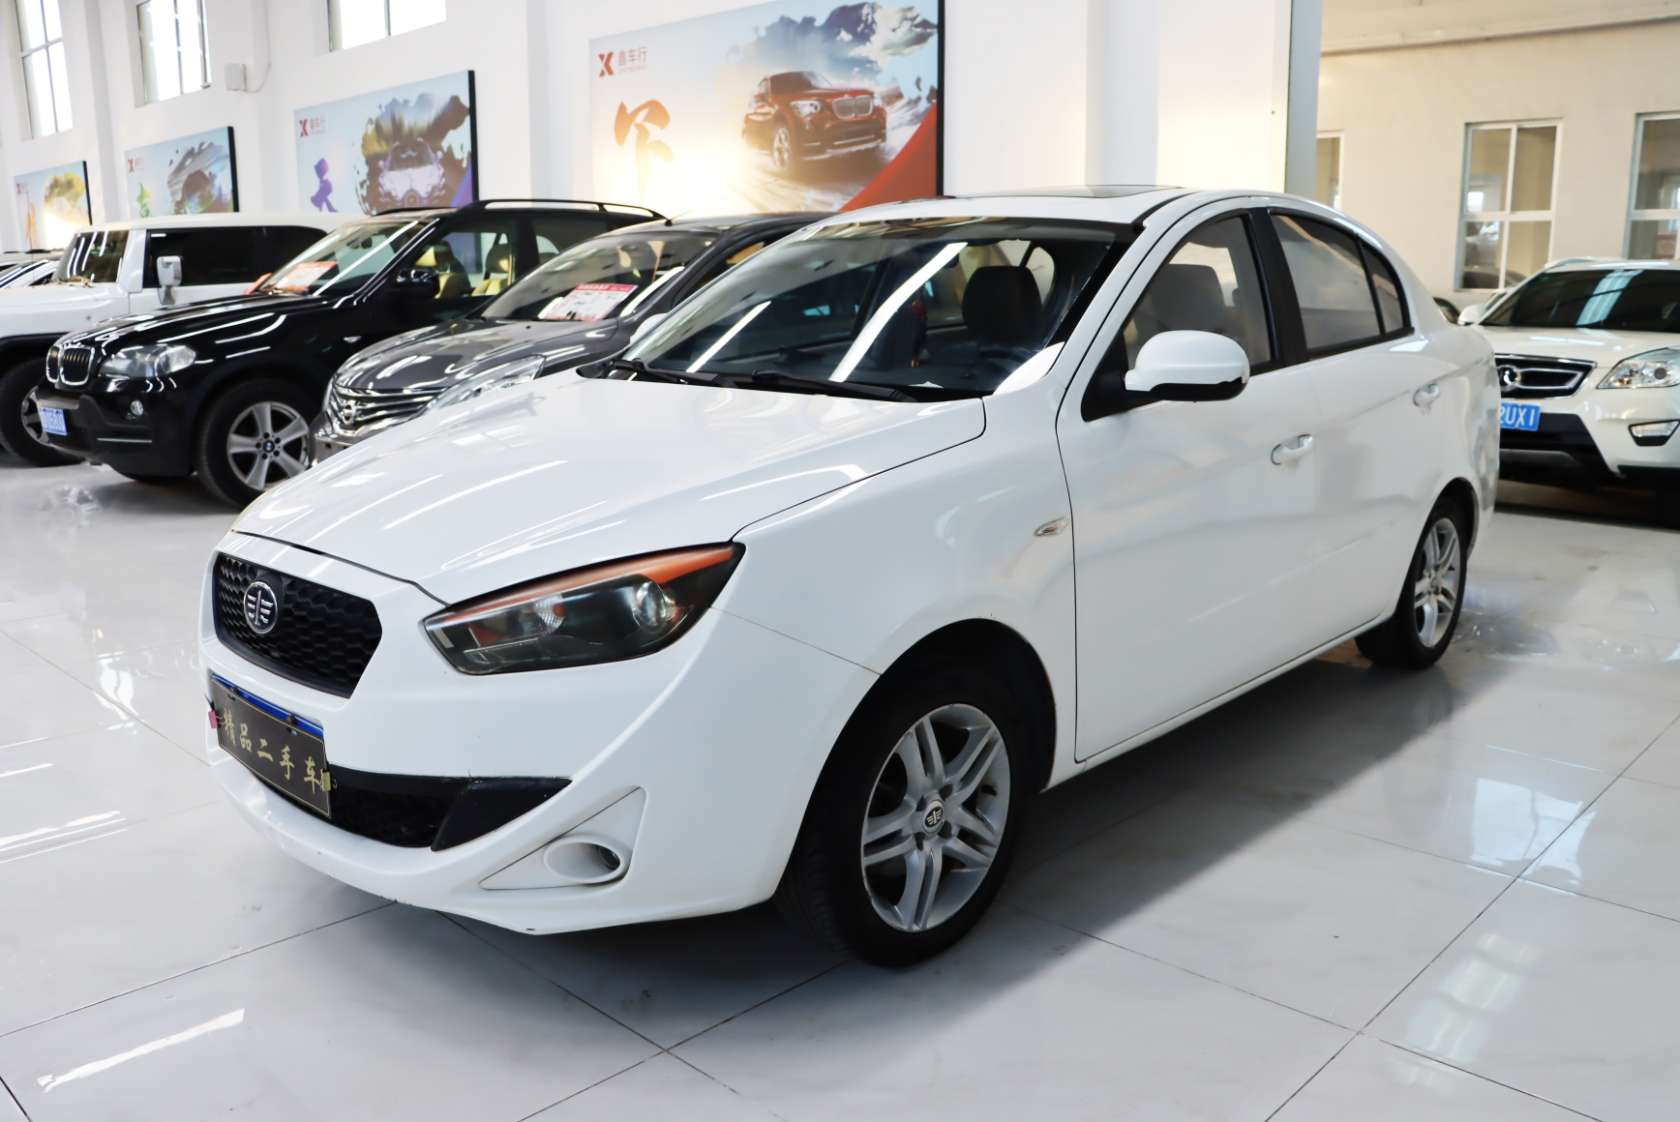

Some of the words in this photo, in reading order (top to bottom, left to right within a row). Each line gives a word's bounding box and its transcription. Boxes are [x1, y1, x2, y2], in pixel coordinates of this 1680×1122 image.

[223, 707, 322, 794] 精品二手车
